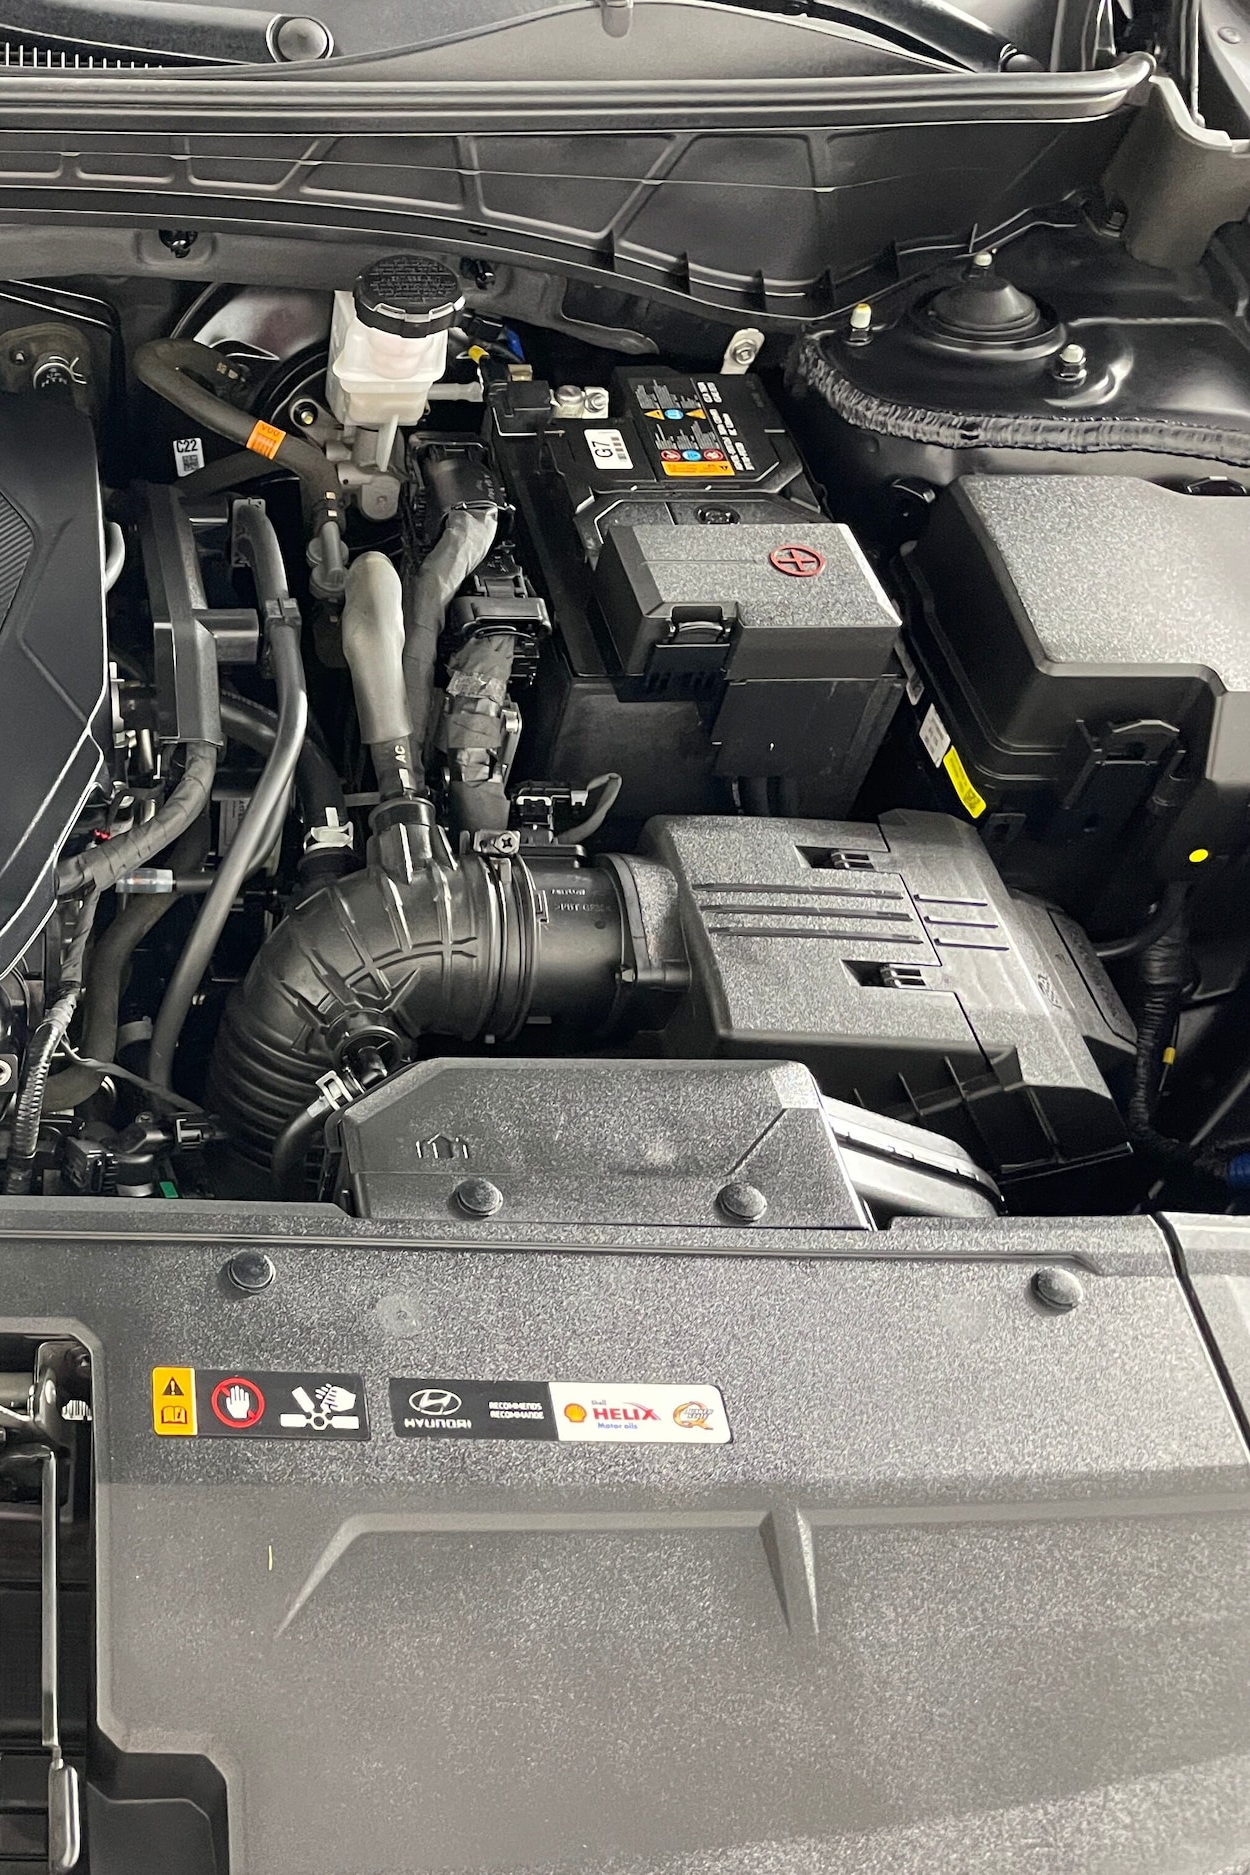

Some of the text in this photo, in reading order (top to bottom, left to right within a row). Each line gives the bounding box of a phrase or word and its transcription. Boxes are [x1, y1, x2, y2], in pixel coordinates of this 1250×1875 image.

[176, 440, 198, 453] C22
[595, 441, 613, 458] G7
[395, 745, 407, 763] AC
[488, 1401, 543, 1411] RECOMMENDS
[593, 1408, 659, 1421] HELIX
[404, 1418, 472, 1429] HYUNDAI
[597, 1422, 638, 1430] Motor oils
